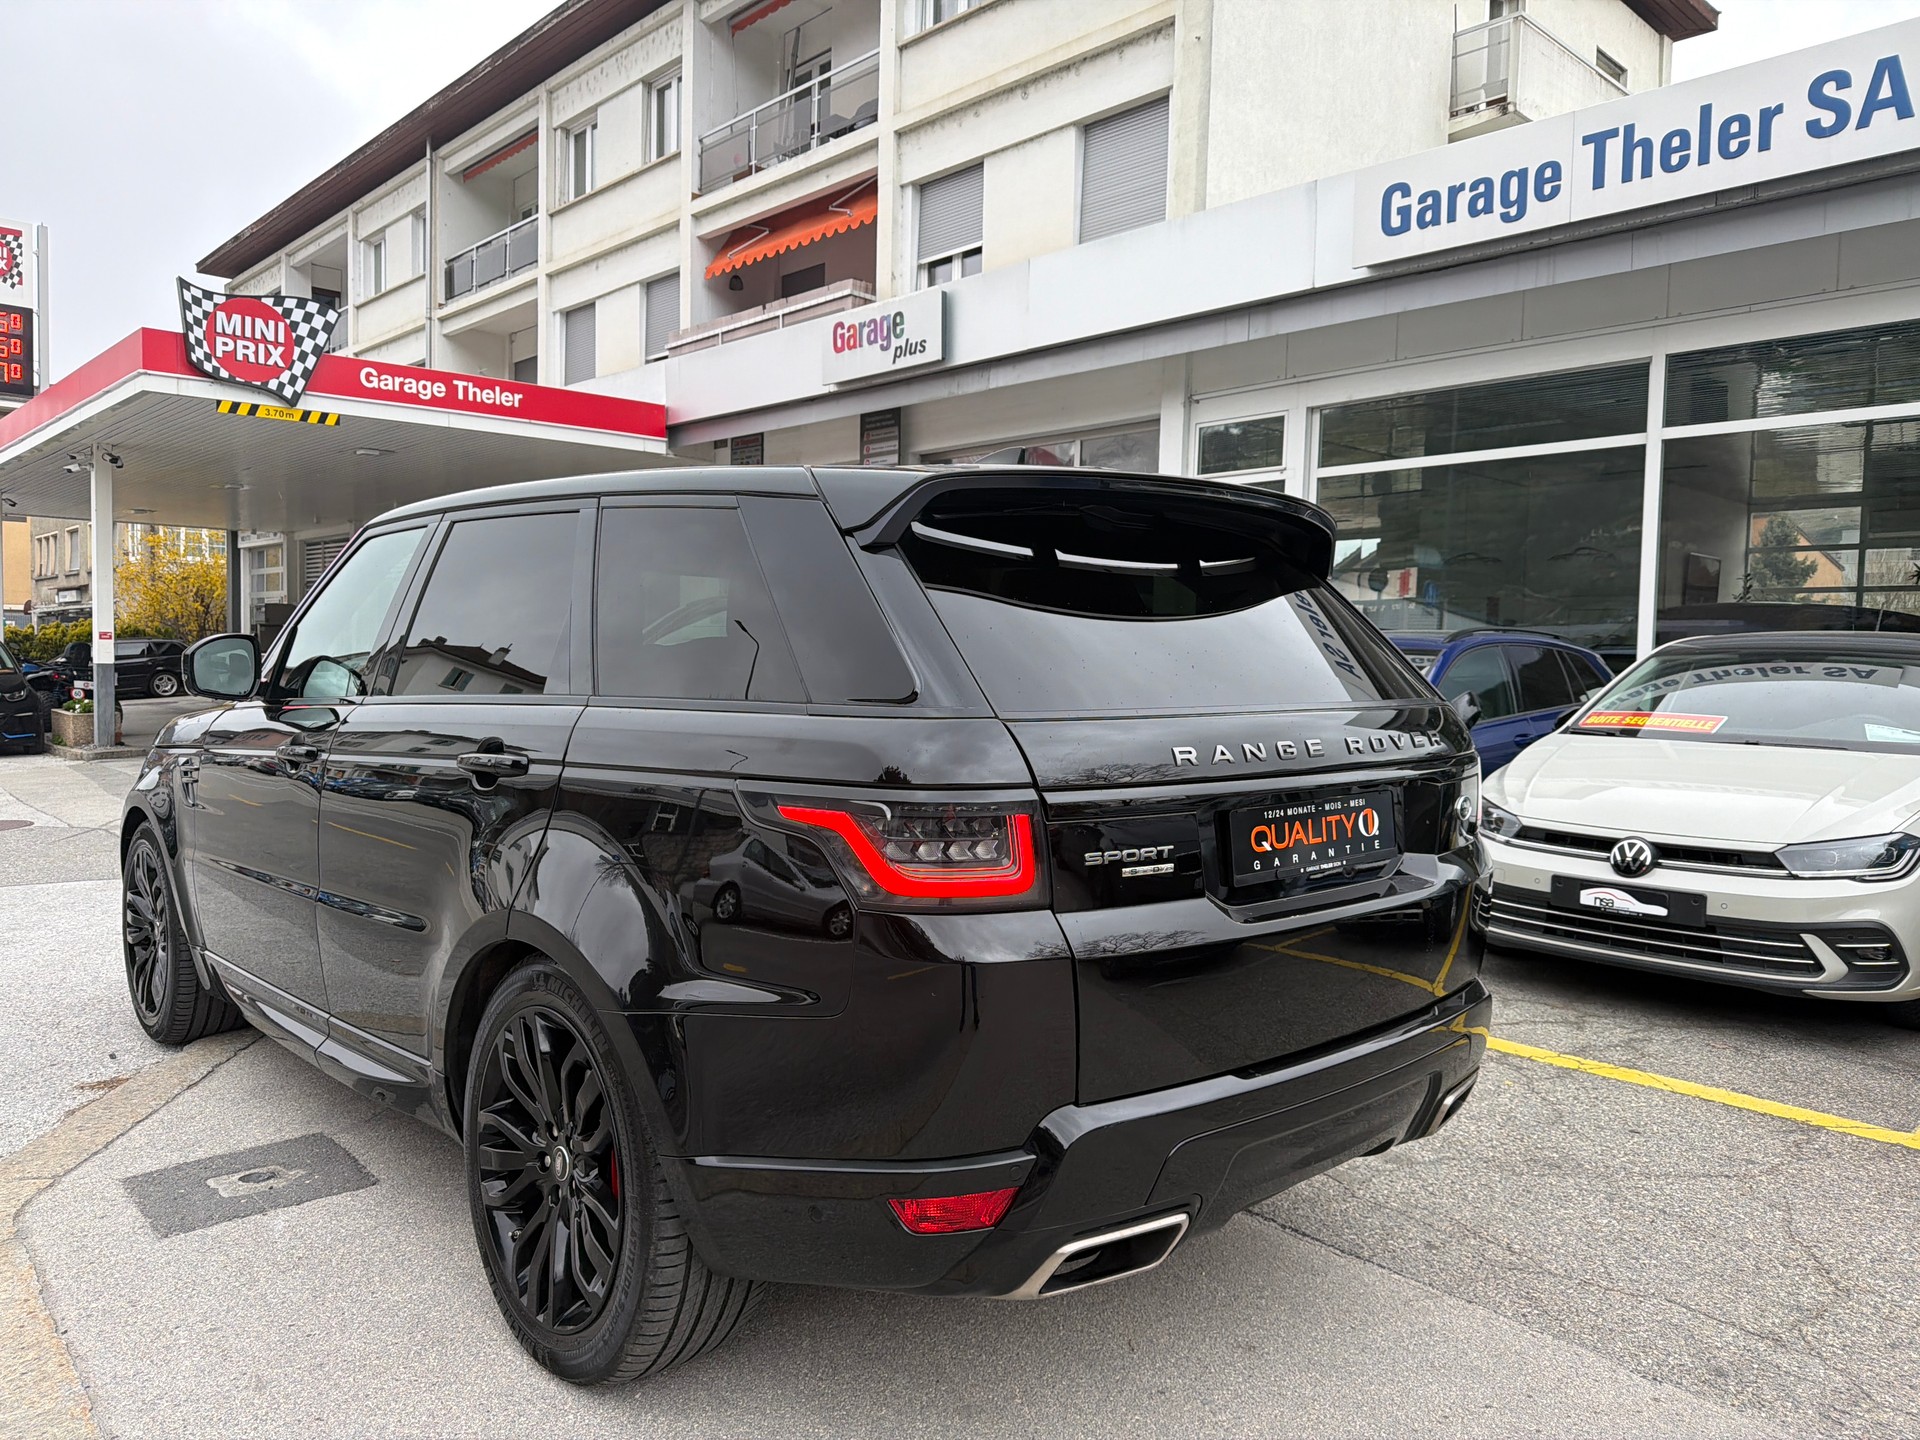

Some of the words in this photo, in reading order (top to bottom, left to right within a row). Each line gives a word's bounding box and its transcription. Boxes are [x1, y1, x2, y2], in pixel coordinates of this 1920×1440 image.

[1381, 160, 1562, 237] Garage
[1582, 102, 1784, 191] Theler
[1805, 54, 1916, 139] SA
[215, 310, 285, 344] MINI
[832, 311, 905, 354] Garage
[215, 336, 286, 368] PRIX
[892, 338, 927, 365] plus
[359, 366, 447, 401] Garage
[452, 379, 524, 408] Theler
[1586, 715, 1623, 724] BOITE
[1622, 715, 1716, 730] SEQUENTIELLE
[1171, 738, 1325, 767] RANGE
[1344, 730, 1444, 755] ROVER
[1264, 810, 1285, 819] 12/24
[1287, 805, 1316, 816] MONATE
[1325, 801, 1341, 811] MOIS
[1350, 798, 1365, 807] MESI
[1250, 812, 1357, 853] QUALITY
[1084, 845, 1175, 866] SPORT
[1253, 840, 1380, 870] GARANTIE
[1594, 896, 1614, 908] nsa
